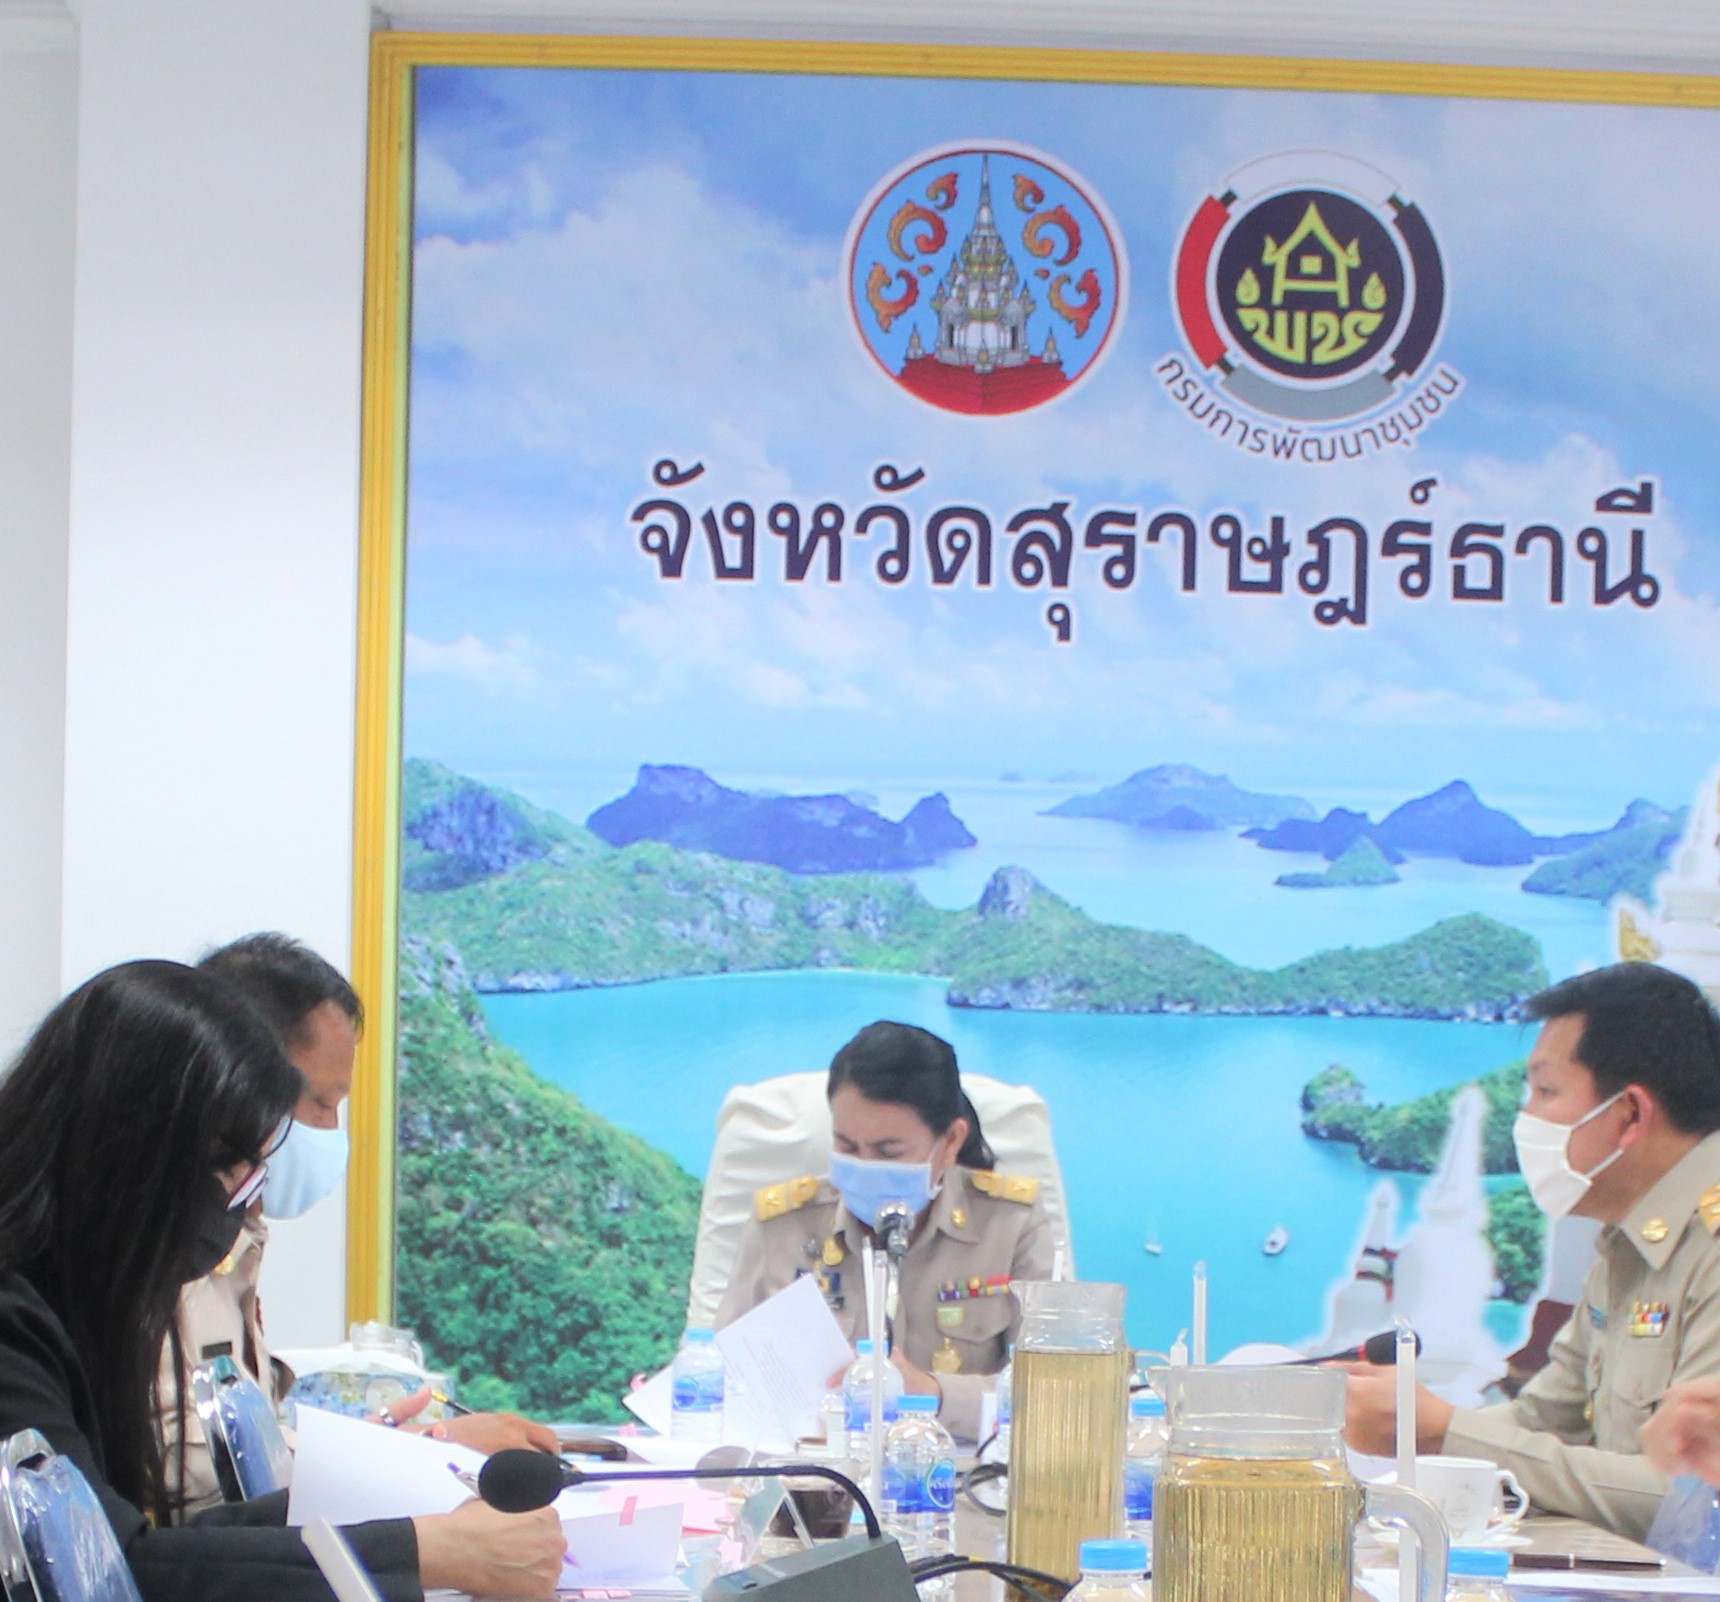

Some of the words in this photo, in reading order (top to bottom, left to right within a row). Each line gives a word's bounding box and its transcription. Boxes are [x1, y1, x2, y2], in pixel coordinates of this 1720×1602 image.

[1156, 357, 1462, 463] กรมการพัฒนาชุมชน
[630, 458, 1662, 643] จังหวัดสุราษฎร์ธานี
